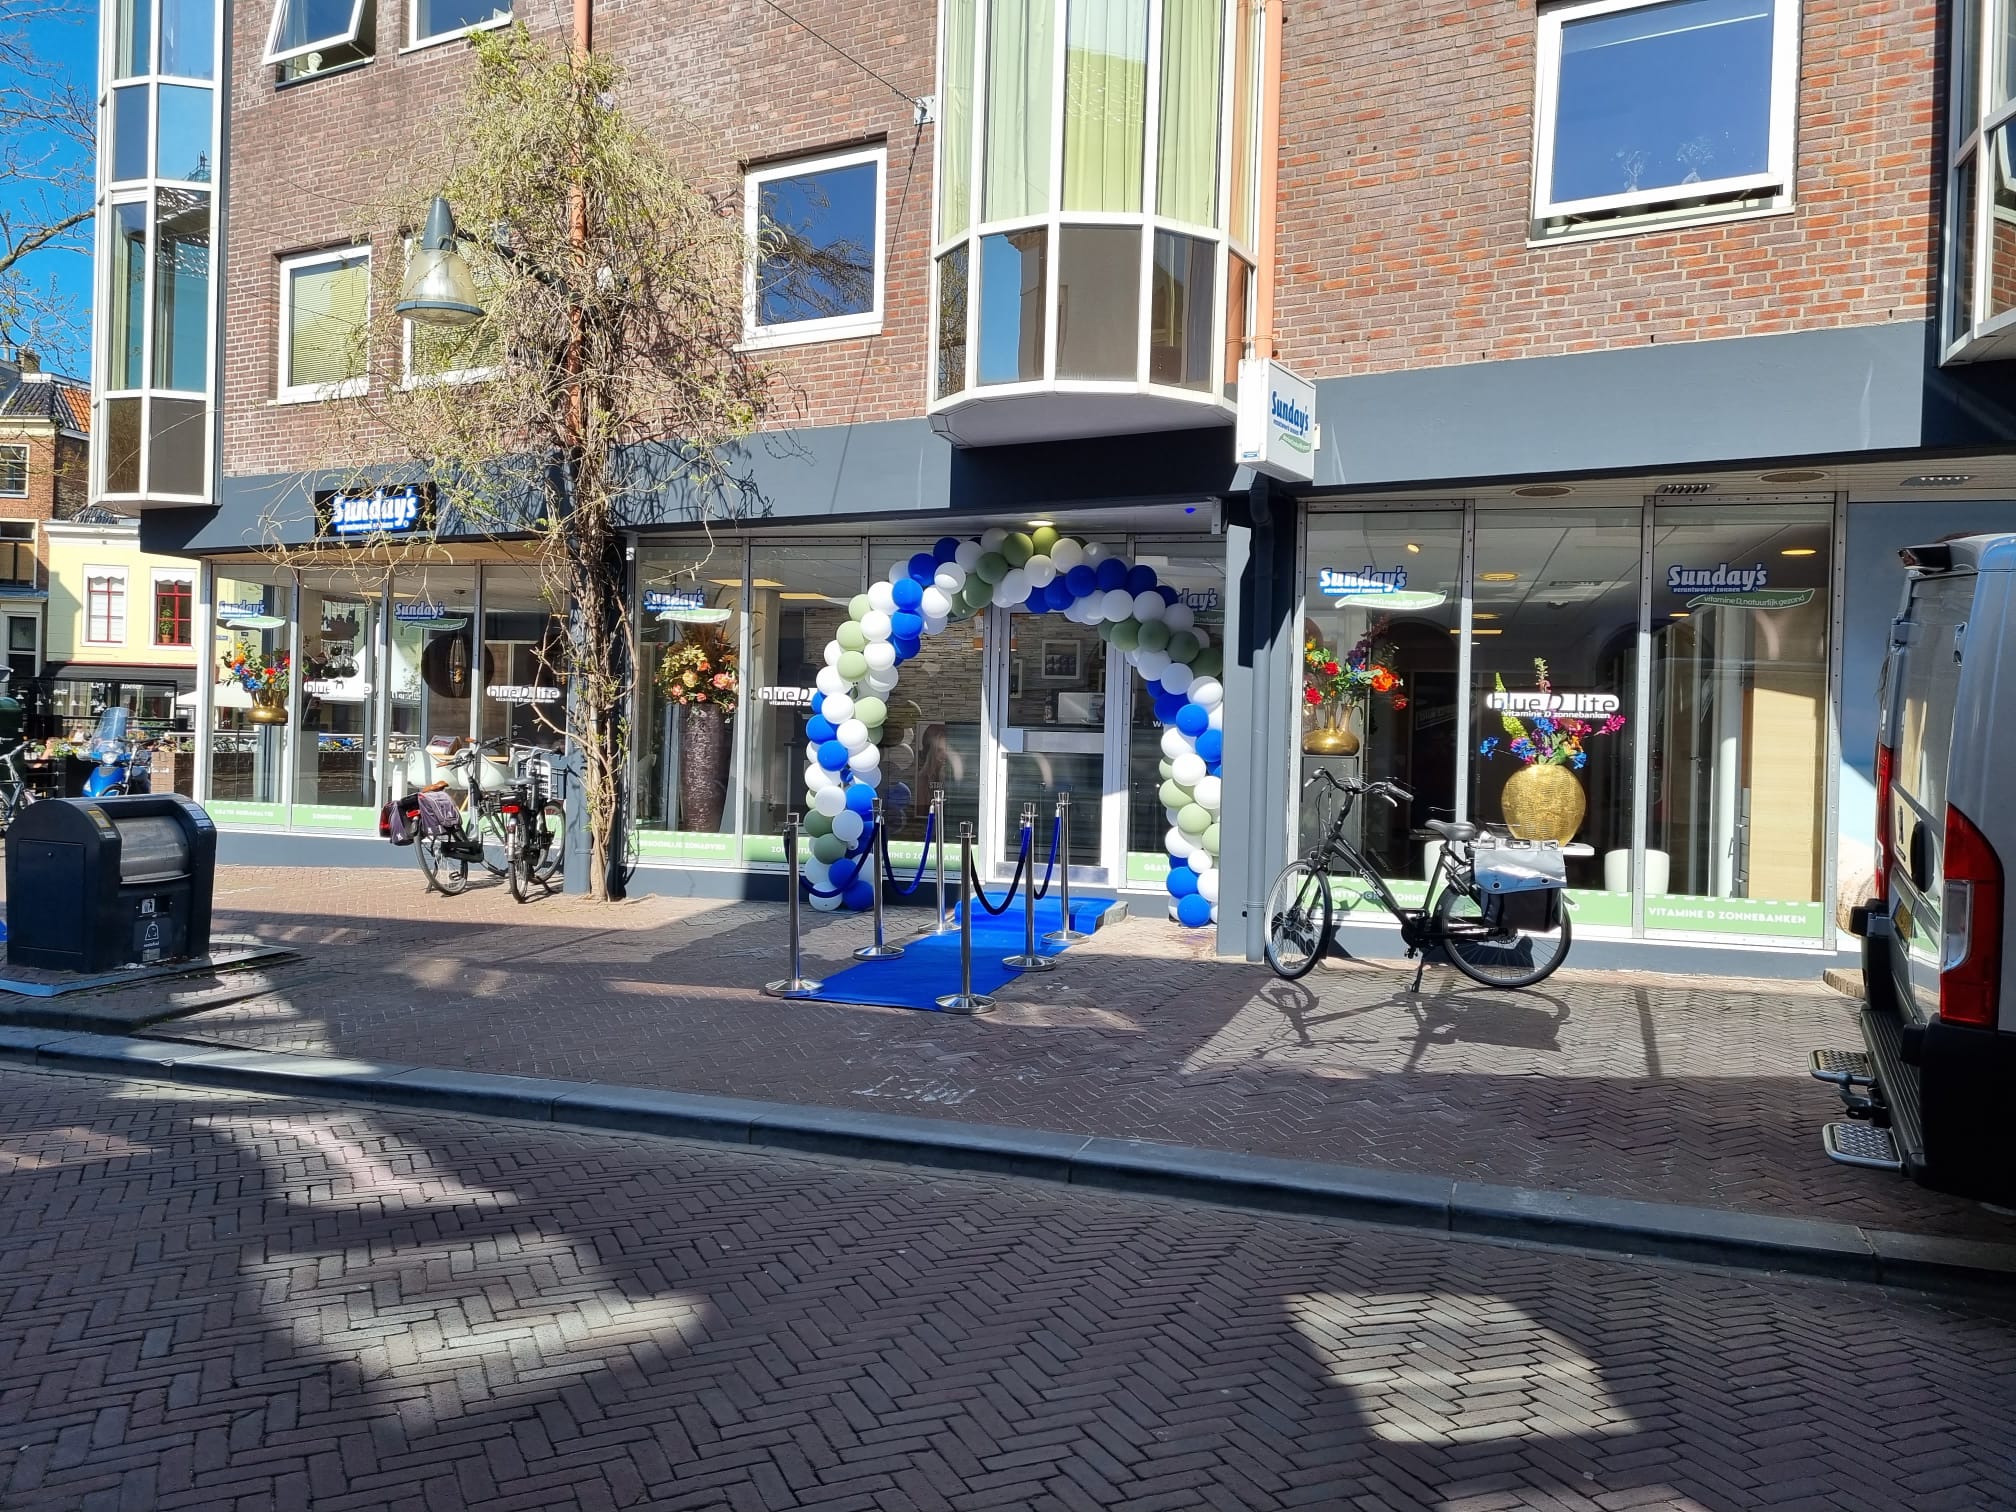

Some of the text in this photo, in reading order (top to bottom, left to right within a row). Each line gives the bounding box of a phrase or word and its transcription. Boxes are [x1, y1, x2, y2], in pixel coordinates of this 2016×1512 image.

[1271, 390, 1309, 436] Sunday's
[333, 488, 417, 526] Sunday's
[1320, 566, 1407, 593] Sunday's
[1667, 563, 1767, 591] Sunday's
[219, 600, 266, 618] Sunday's
[644, 588, 705, 610] Sunday's
[1178, 588, 1218, 611] day's
[395, 602, 445, 620] Sunday's
[1491, 693, 1542, 711] blue
[1575, 694, 1616, 710] lite
[1502, 710, 1542, 718] vitamine
[1553, 711, 1611, 719] zonnebanken
[1648, 907, 1807, 924] VITAMINE D ZONNEBANKEN
